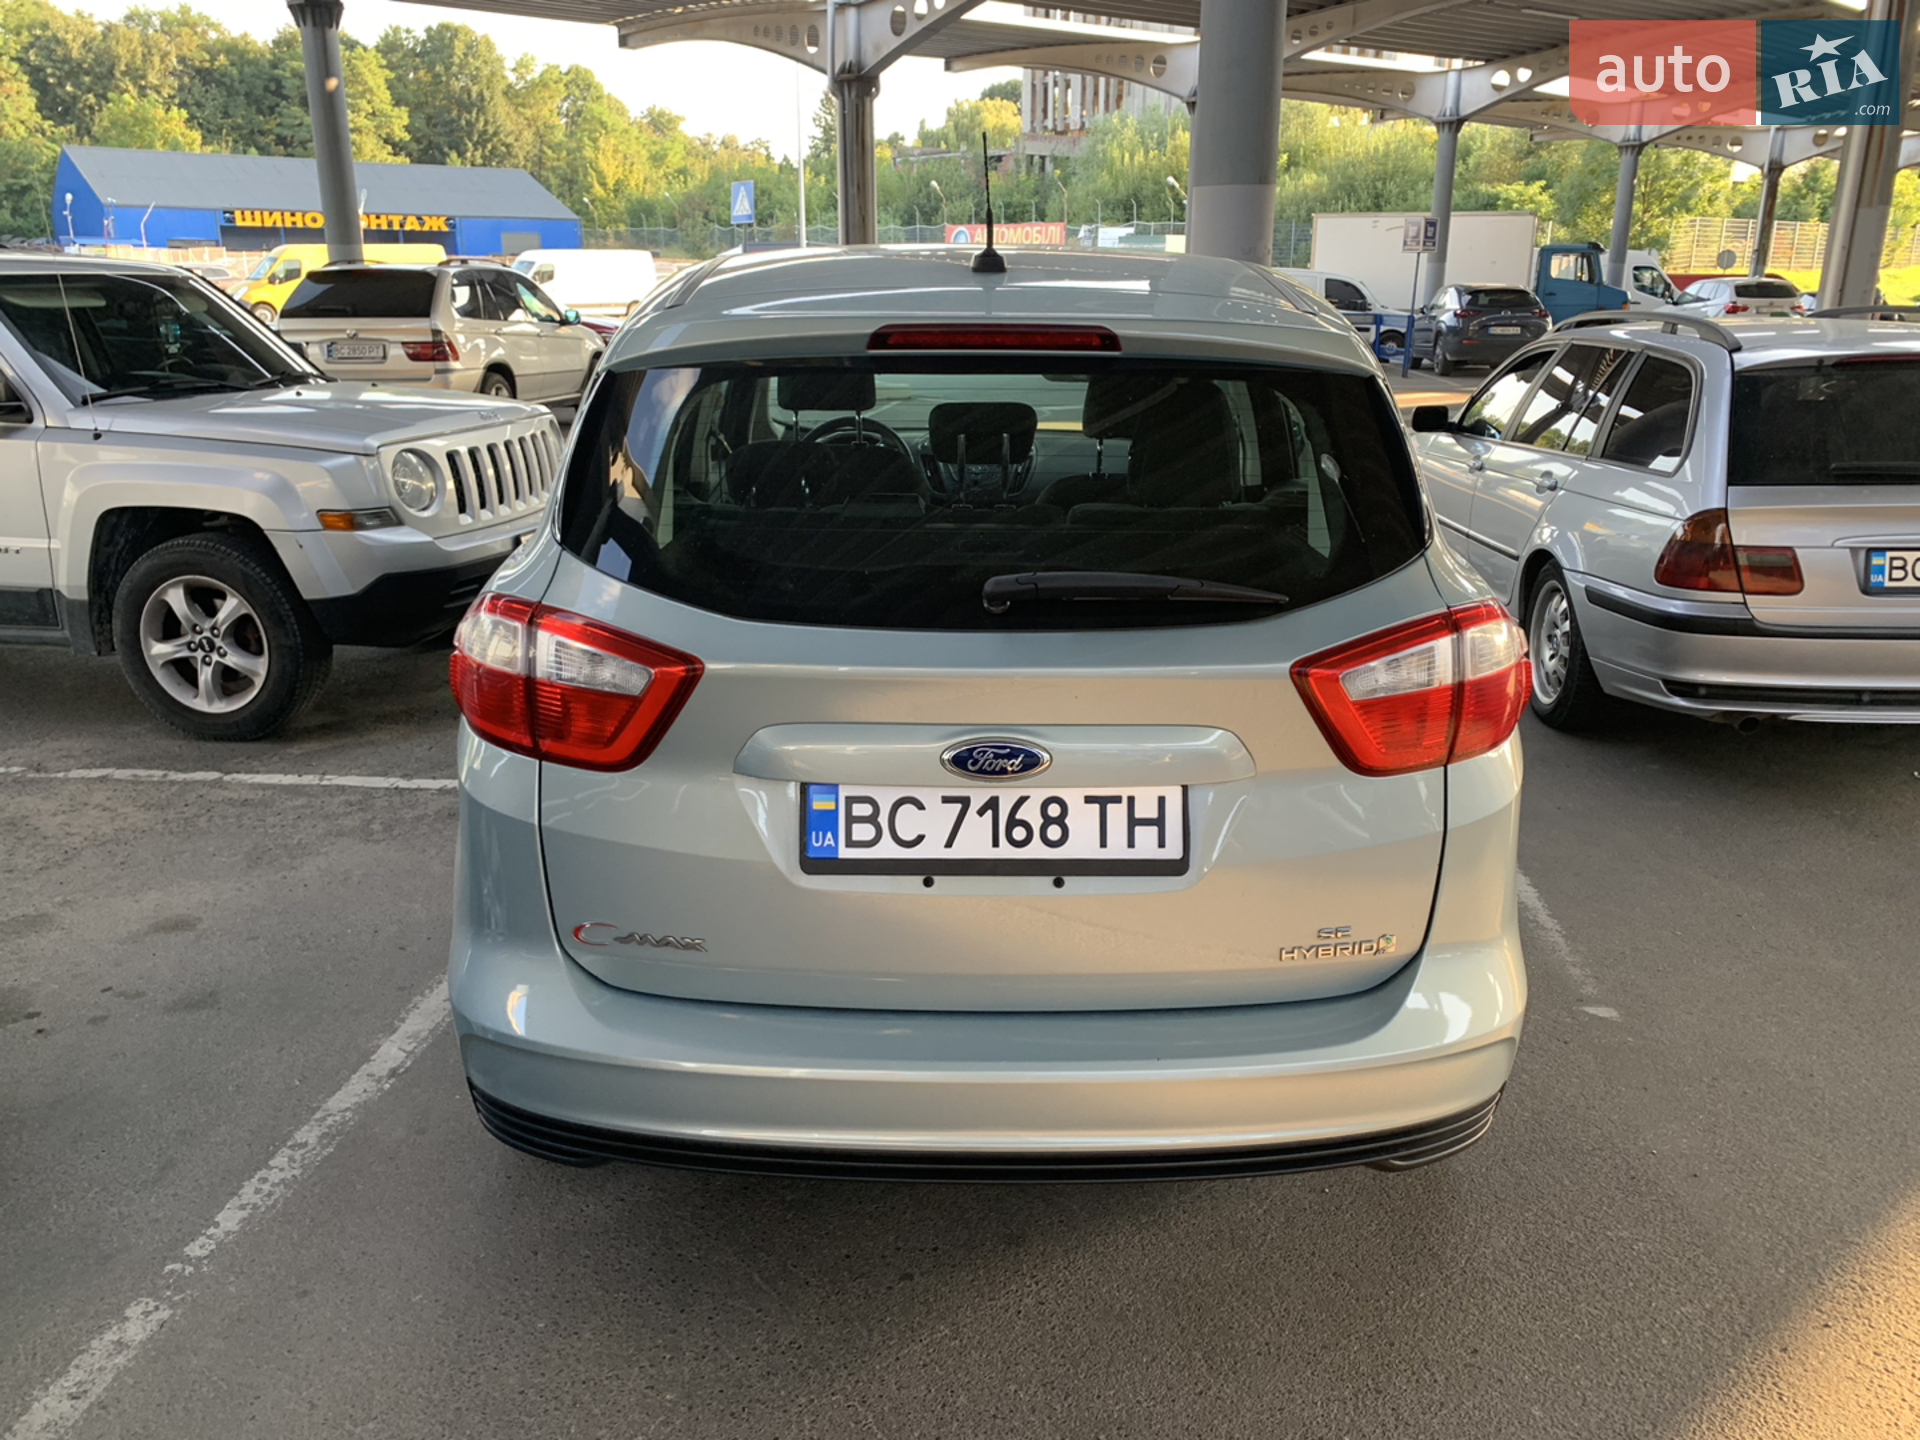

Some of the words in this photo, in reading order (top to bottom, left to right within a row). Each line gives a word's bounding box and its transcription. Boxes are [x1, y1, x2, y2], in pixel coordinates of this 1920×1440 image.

[234, 210, 449, 232] ШИНОНТАЖ
[967, 747, 1023, 772] Ford
[844, 795, 927, 849] BC
[941, 795, 1070, 849] 7168
[1084, 795, 1167, 849] TH
[811, 831, 836, 848] UA
[1279, 939, 1378, 961] HYBRID
